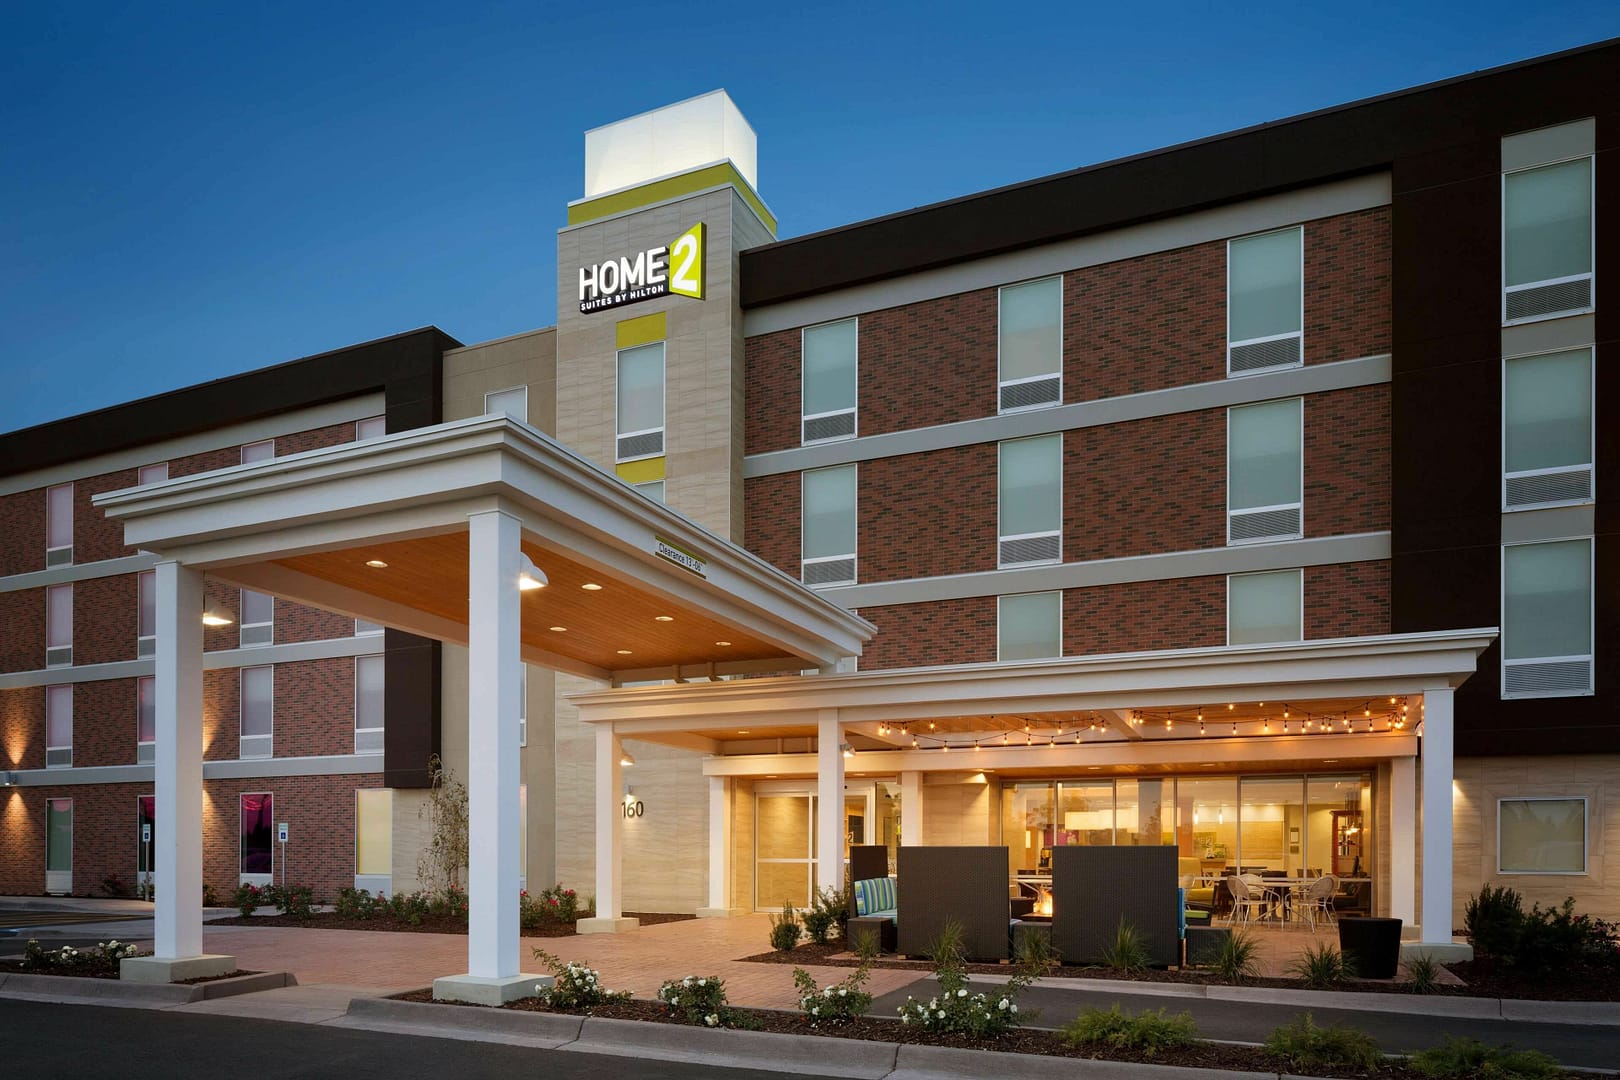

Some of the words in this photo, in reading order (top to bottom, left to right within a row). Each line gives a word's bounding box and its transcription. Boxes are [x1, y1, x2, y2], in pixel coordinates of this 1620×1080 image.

[579, 246, 666, 300] HOME
[671, 234, 698, 292] 2
[581, 296, 612, 311] SUITES
[615, 293, 627, 303] BY
[630, 285, 664, 299] HILTON
[658, 542, 685, 564] Clearance
[621, 801, 644, 818] 160
